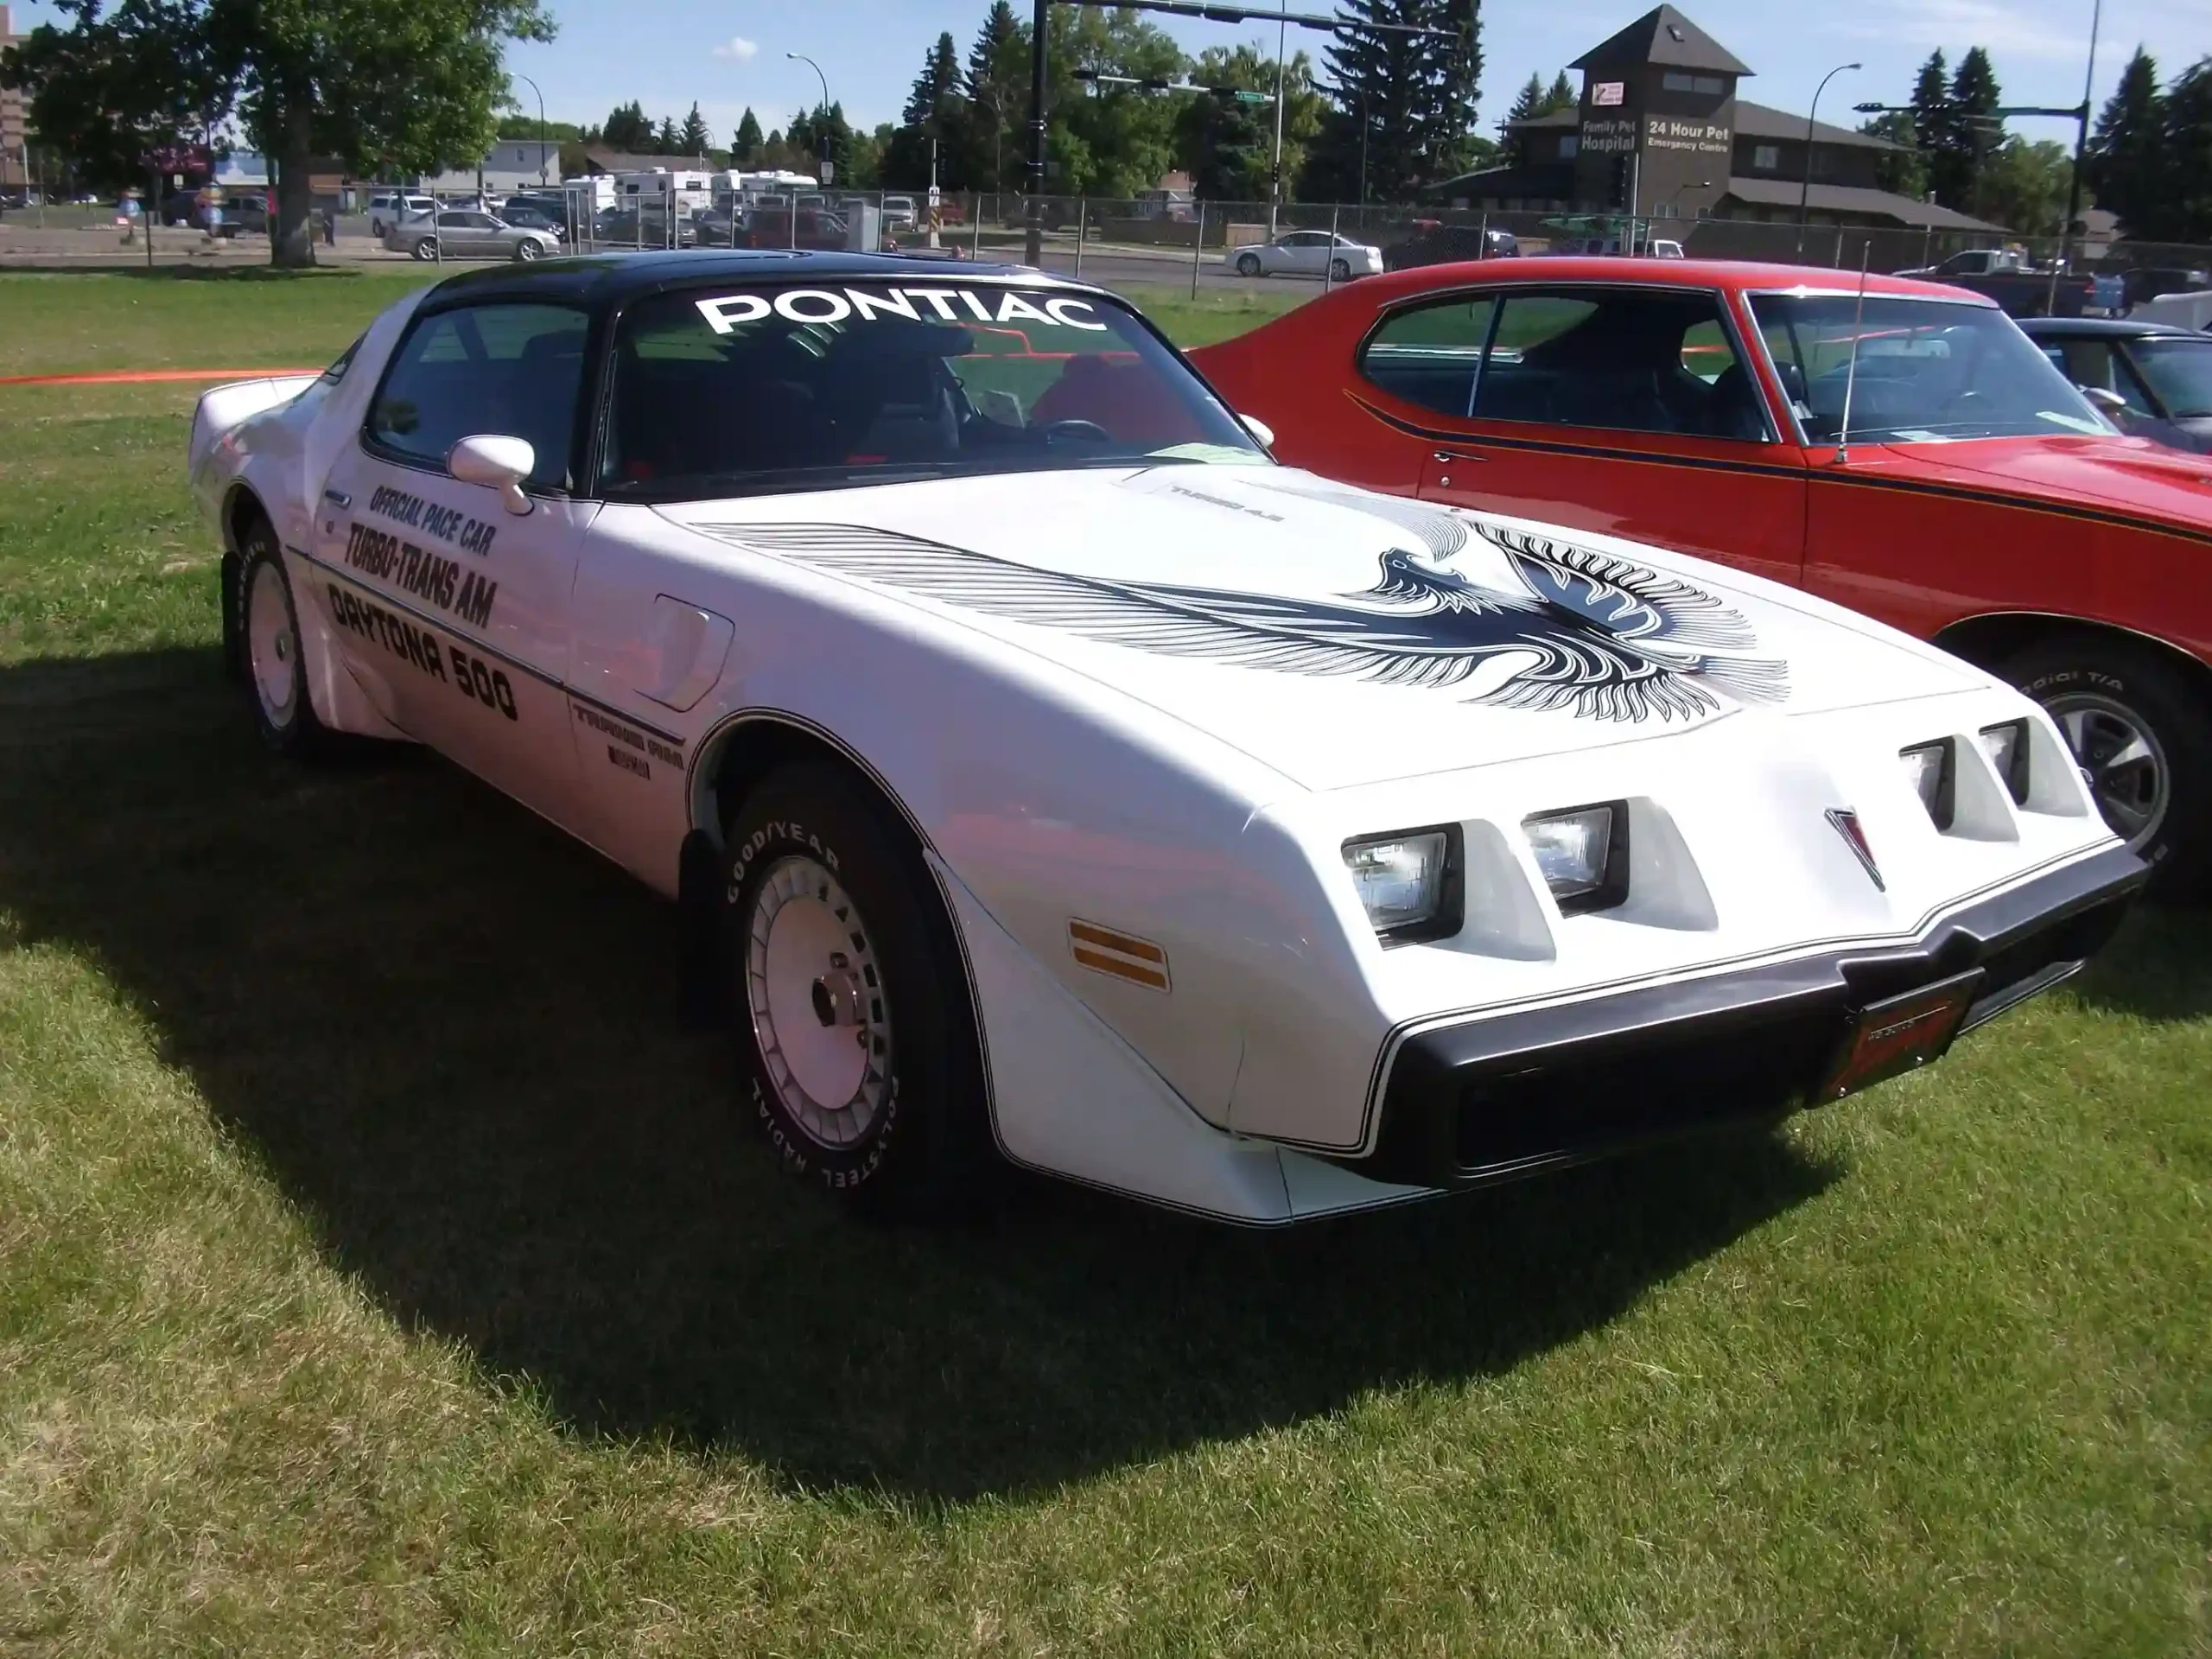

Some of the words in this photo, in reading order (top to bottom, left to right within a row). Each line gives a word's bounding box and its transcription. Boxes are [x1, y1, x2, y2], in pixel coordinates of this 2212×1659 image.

[1582, 136, 1635, 153] Hospital
[1583, 120, 1615, 135] Family
[1618, 120, 1636, 132] Pet
[1648, 137, 1696, 152] Emergency
[1649, 121, 1666, 134] 24
[1670, 123, 1702, 138] Hour
[1706, 125, 1728, 140] Pet
[695, 288, 1108, 335] PONTIAC
[370, 485, 425, 526] OFFICIAL
[421, 503, 463, 542] PACE
[460, 518, 497, 556] CAR
[345, 522, 461, 610] TURBO-TRANS
[454, 569, 498, 629] AM
[327, 582, 448, 683] DAYTONA
[449, 645, 518, 721] 500
[2018, 671, 2079, 695] adial
[727, 820, 839, 904] GOODYEAR
